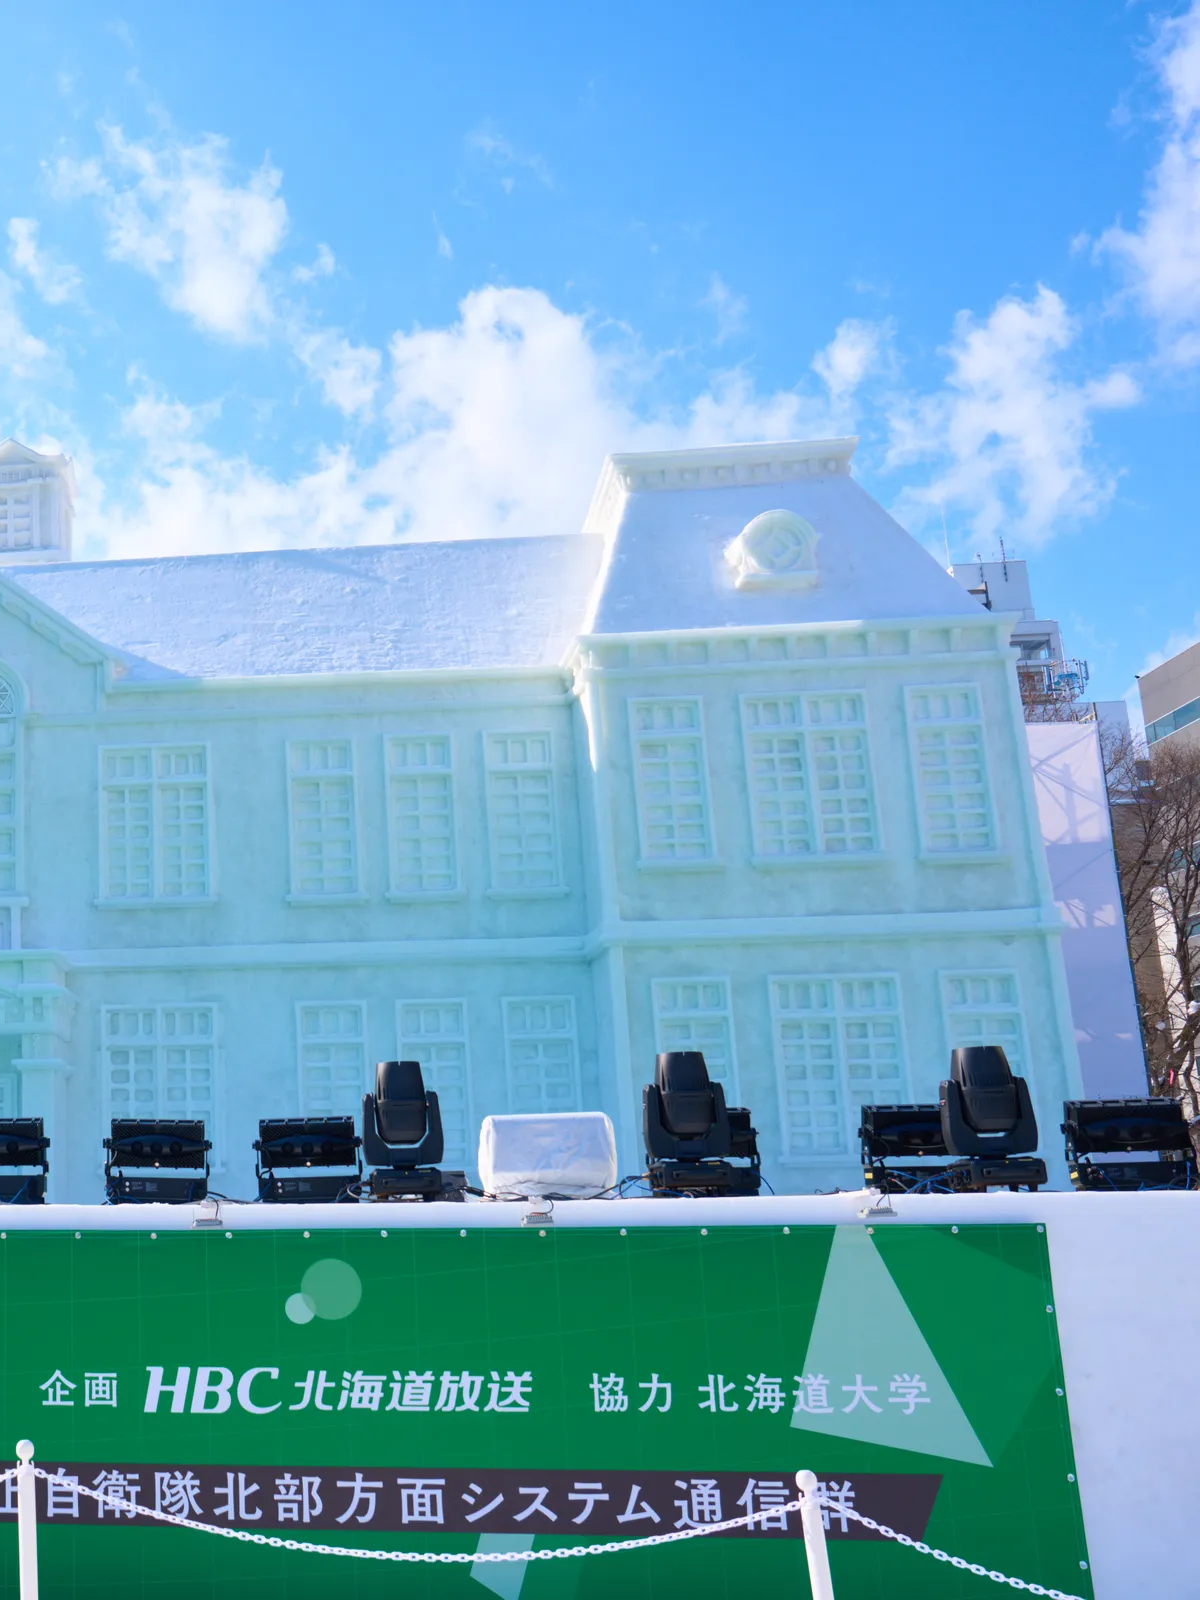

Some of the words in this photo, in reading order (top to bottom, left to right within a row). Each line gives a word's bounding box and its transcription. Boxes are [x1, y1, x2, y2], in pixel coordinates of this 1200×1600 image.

[39, 1369, 119, 1408] 企画
[589, 1372, 674, 1413] 協力
[698, 1373, 932, 1415] 北海道大学
